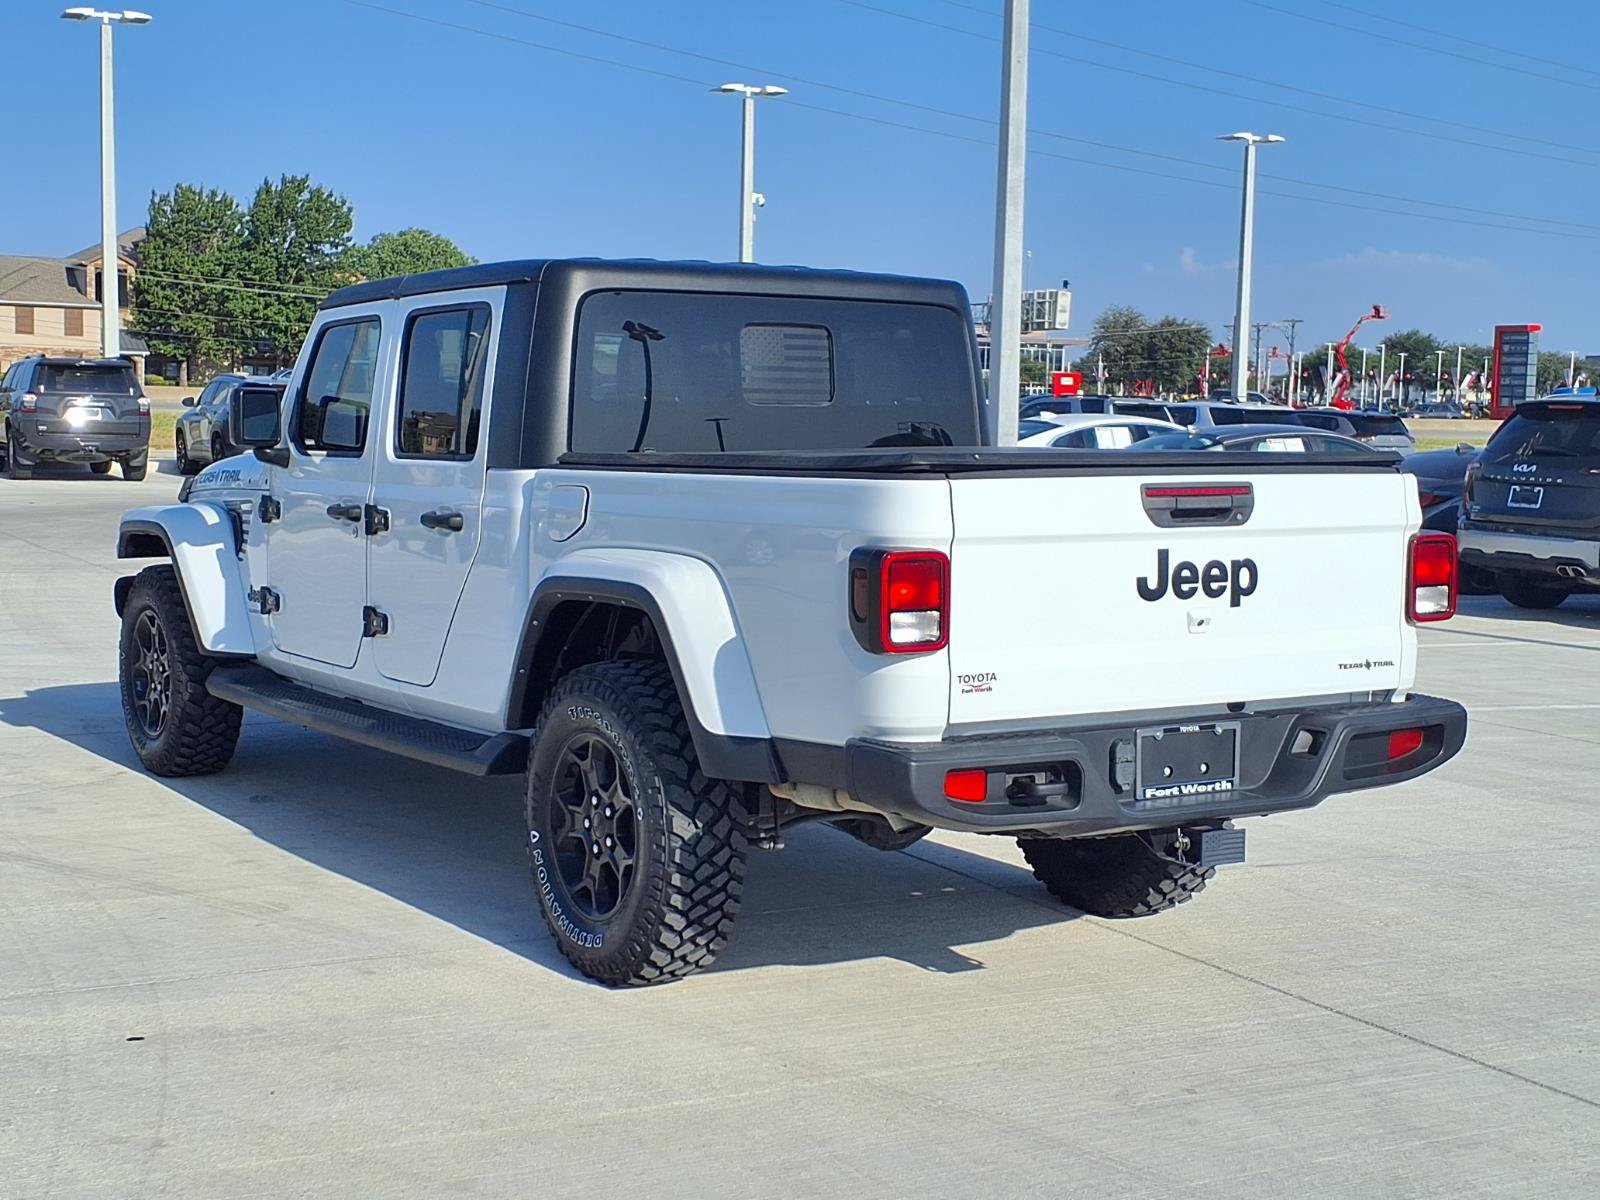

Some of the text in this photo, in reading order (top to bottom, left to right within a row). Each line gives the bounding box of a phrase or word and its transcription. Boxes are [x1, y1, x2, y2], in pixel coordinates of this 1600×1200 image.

[220, 469, 242, 482] TRAIL
[1136, 548, 1258, 608] Jeep
[956, 672, 997, 684] TOYOTA
[1179, 725, 1200, 733] TOYOTA
[1145, 780, 1232, 799] Fort Worth
[532, 849, 603, 948] DESTINATION
